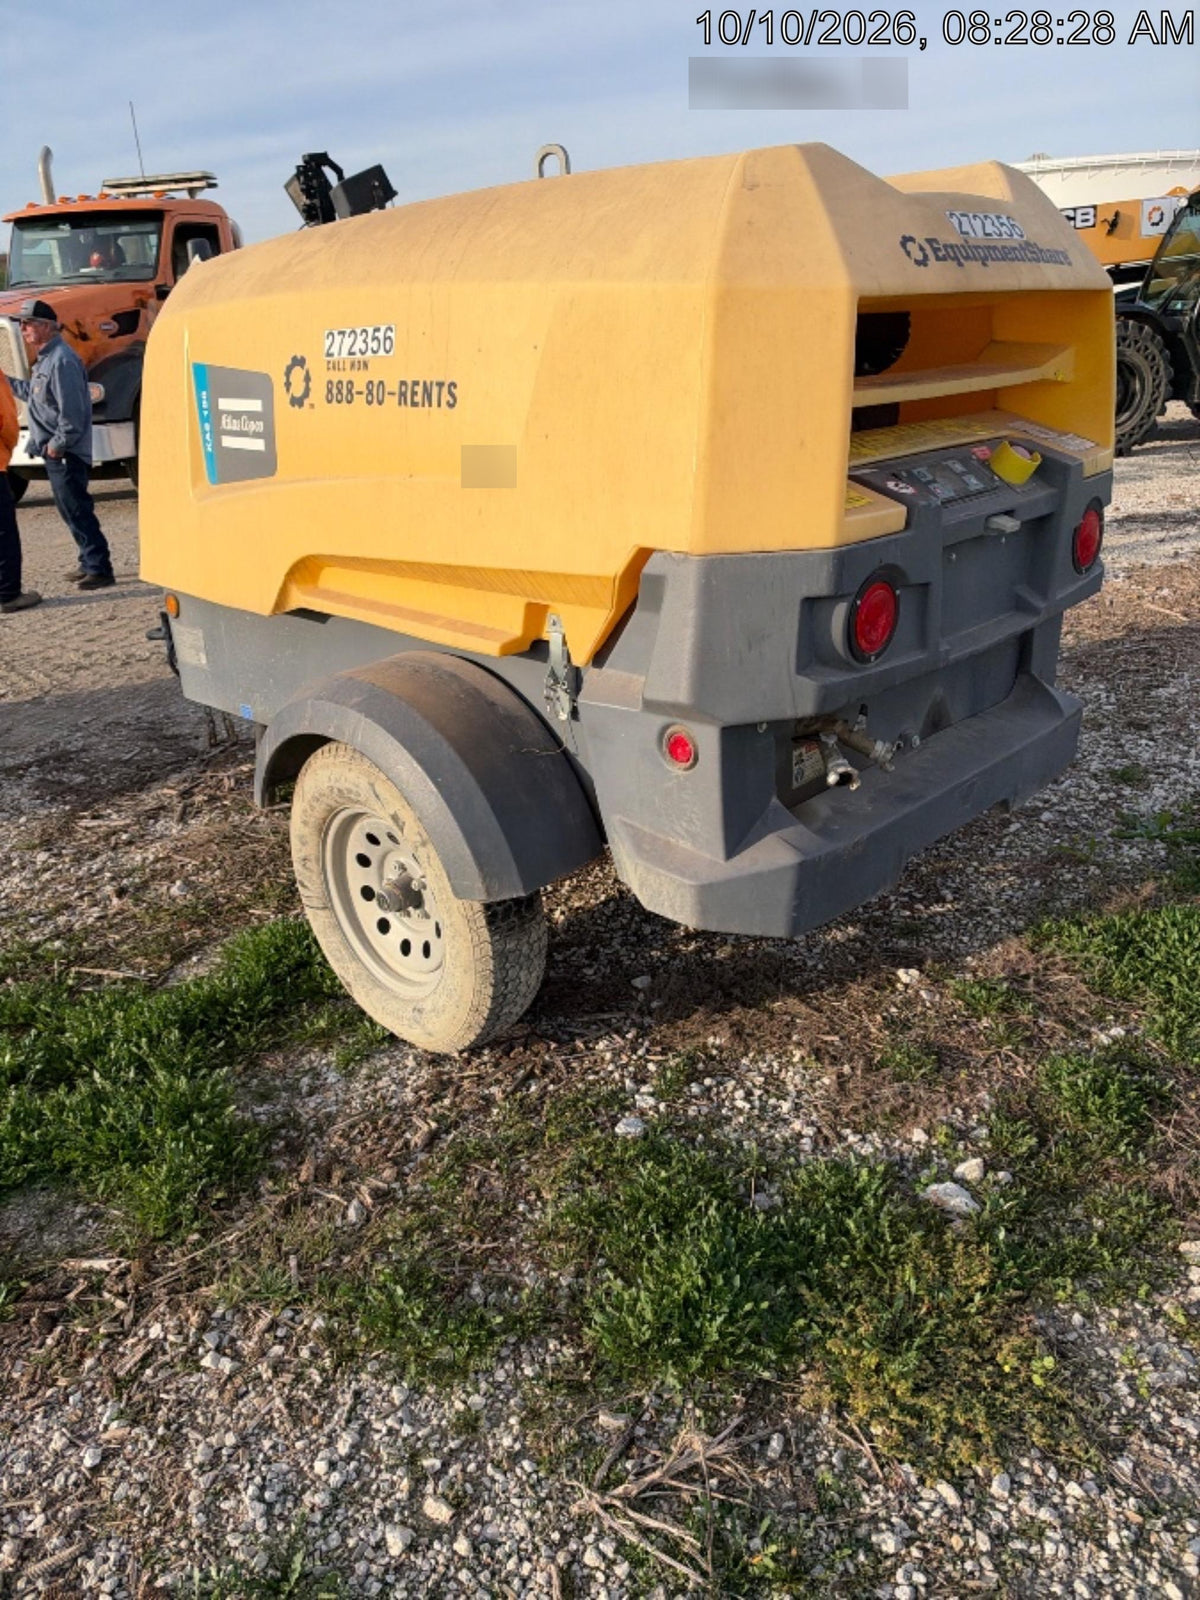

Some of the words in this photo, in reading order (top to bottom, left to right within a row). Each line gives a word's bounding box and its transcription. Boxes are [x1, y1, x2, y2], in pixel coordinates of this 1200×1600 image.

[950, 212, 1025, 238] 272356
[1060, 206, 1095, 229] CB
[924, 238, 1073, 267] EquipmentShare
[325, 326, 394, 357] 272356
[326, 359, 346, 371] CALL
[350, 359, 369, 371] NOW
[325, 379, 458, 409] 888-80-RENTS
